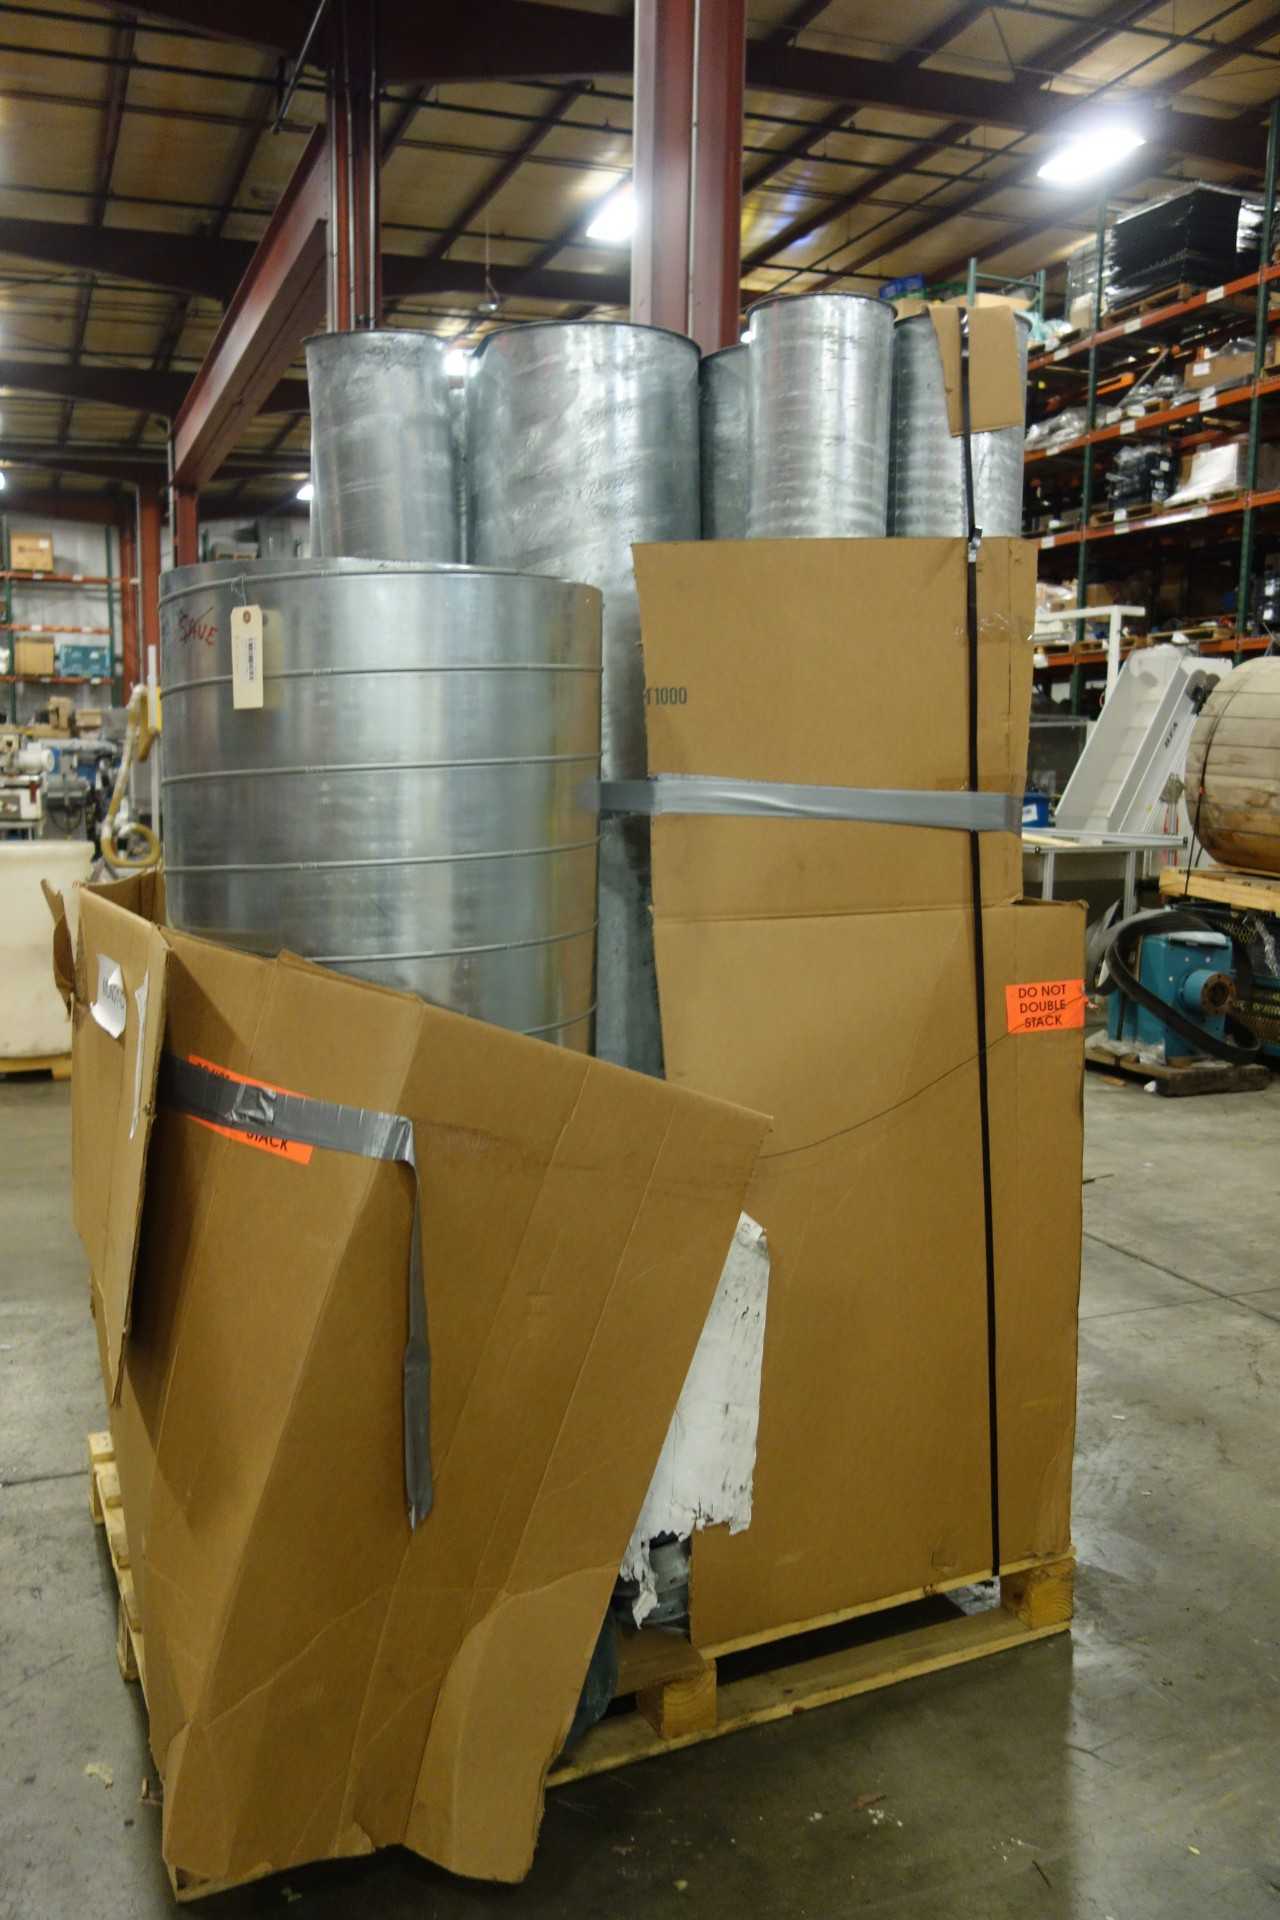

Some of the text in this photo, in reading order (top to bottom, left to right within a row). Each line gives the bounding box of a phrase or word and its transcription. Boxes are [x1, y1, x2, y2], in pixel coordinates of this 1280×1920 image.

[1018, 984, 1066, 999] DO NOT
[1019, 999, 1067, 1014] DOUBLE
[1024, 1015, 1062, 1028] STACK
